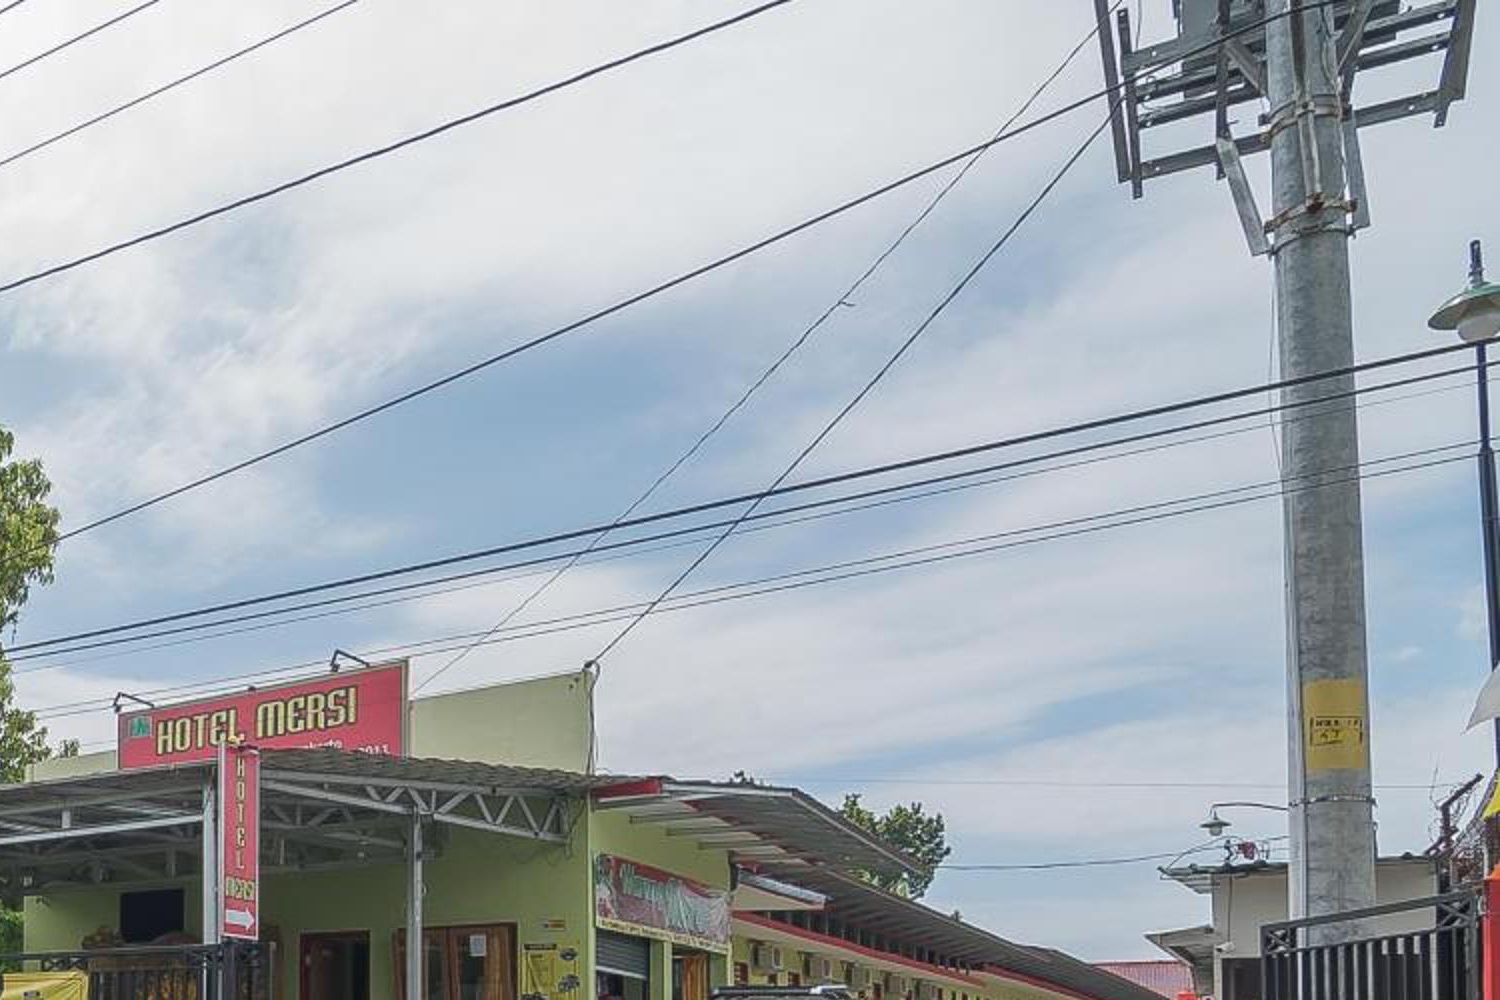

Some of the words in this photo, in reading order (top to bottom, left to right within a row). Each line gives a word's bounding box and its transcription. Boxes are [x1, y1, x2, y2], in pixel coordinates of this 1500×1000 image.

[156, 708, 242, 755] HOTEL
[256, 685, 358, 739] MERSI
[235, 756, 246, 869] HOTEL
[225, 875, 256, 900] MERSI
